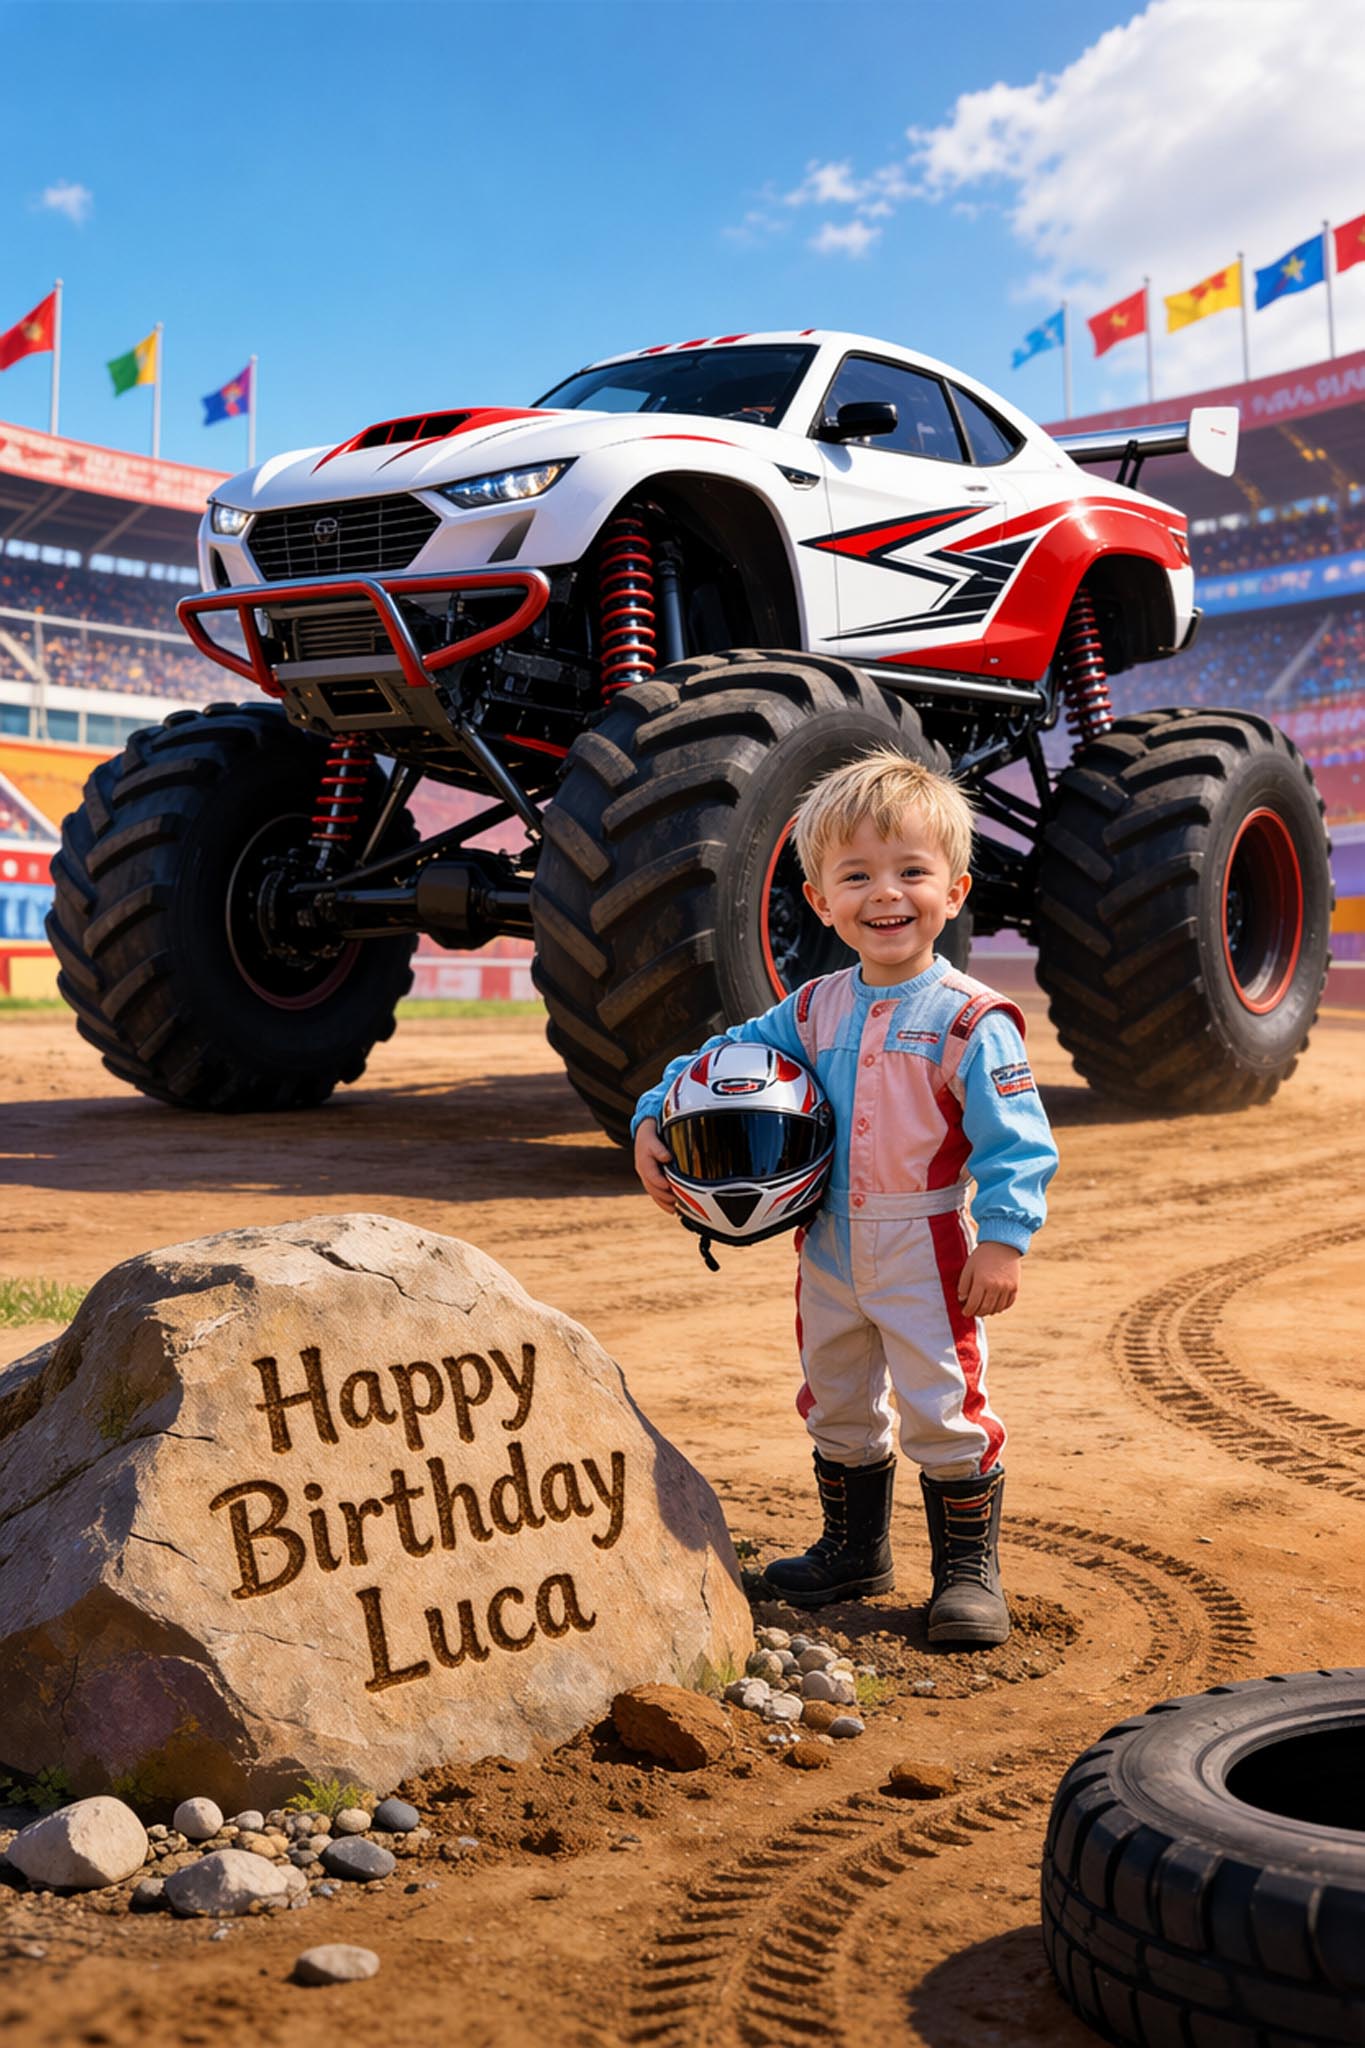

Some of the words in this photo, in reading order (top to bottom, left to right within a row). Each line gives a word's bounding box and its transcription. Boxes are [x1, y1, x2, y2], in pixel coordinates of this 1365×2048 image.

[252, 1343, 536, 1453] Happy
[209, 1441, 626, 1600] Birthday
[356, 1573, 596, 1692] Luca
